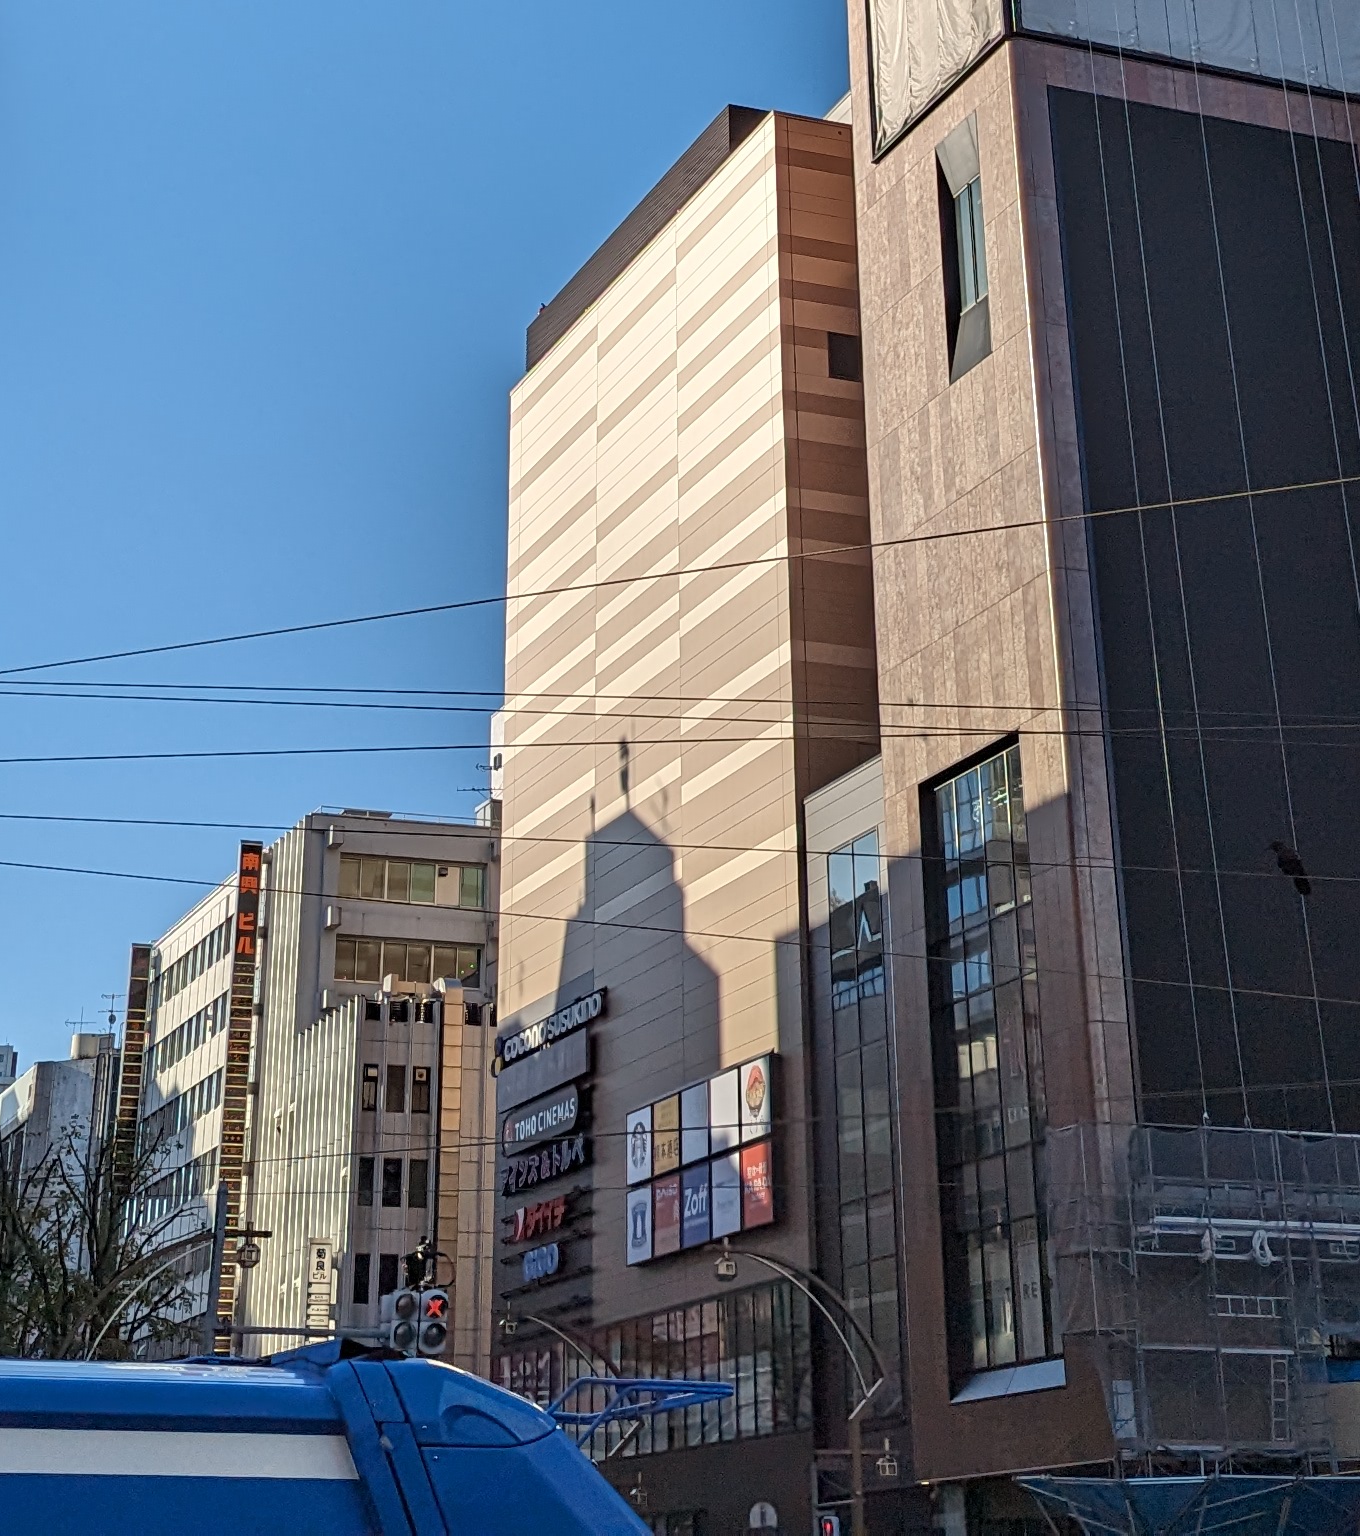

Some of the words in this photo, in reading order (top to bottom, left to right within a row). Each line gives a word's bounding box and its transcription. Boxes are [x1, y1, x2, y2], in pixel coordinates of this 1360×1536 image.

[514, 1115, 537, 1143] TOHO
[537, 1097, 577, 1132] CINEMAS
[684, 1182, 708, 1219] Zoff
